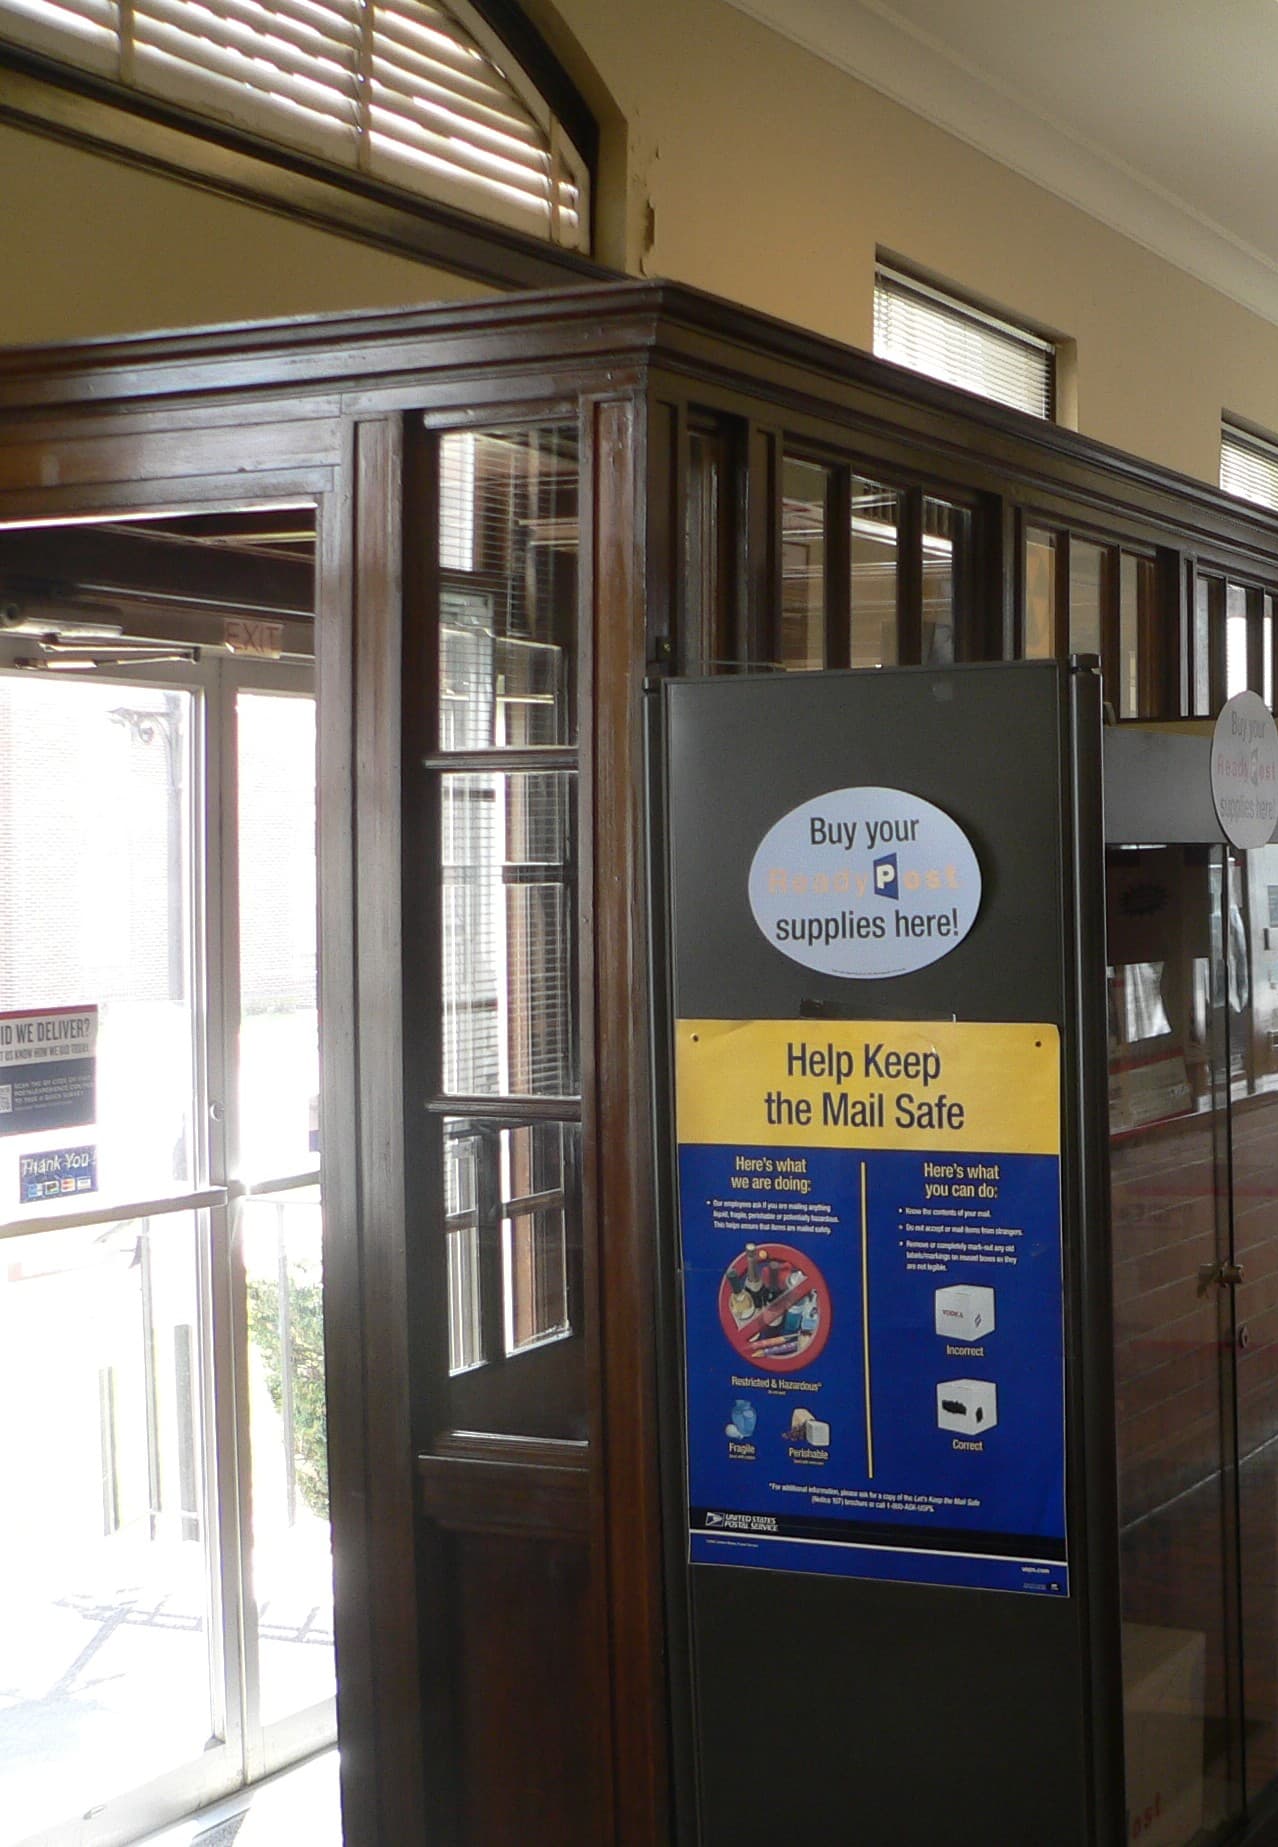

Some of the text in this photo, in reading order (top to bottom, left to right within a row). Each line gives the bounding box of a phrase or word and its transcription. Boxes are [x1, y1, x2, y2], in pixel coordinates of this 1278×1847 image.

[1231, 710, 1249, 745] Buy
[810, 816, 919, 850] Buy your
[767, 858, 961, 898] ReadyPost
[776, 907, 959, 946] supplies here!
[15, 1023, 33, 1044] WE
[36, 1018, 91, 1042] DELIVER?
[787, 1042, 941, 1087] Help Keep
[764, 1091, 965, 1130] the Mail Safe
[22, 1156, 62, 1177] Thank
[736, 1155, 807, 1173] Here's what
[924, 1162, 1000, 1179] Here's what
[730, 1175, 812, 1194] we are doing:
[925, 1182, 998, 1199] you can do:
[964, 1210, 977, 1219] your
[946, 1344, 985, 1356] Incorrect
[731, 1375, 770, 1388] Restricted
[770, 1379, 778, 1389] &
[728, 1442, 756, 1455] Fragile
[788, 1447, 829, 1460] Perishable
[952, 1439, 983, 1451] Correct
[725, 1513, 777, 1525] UNITED STATES
[725, 1521, 779, 1531] POSTAL SERVICE
